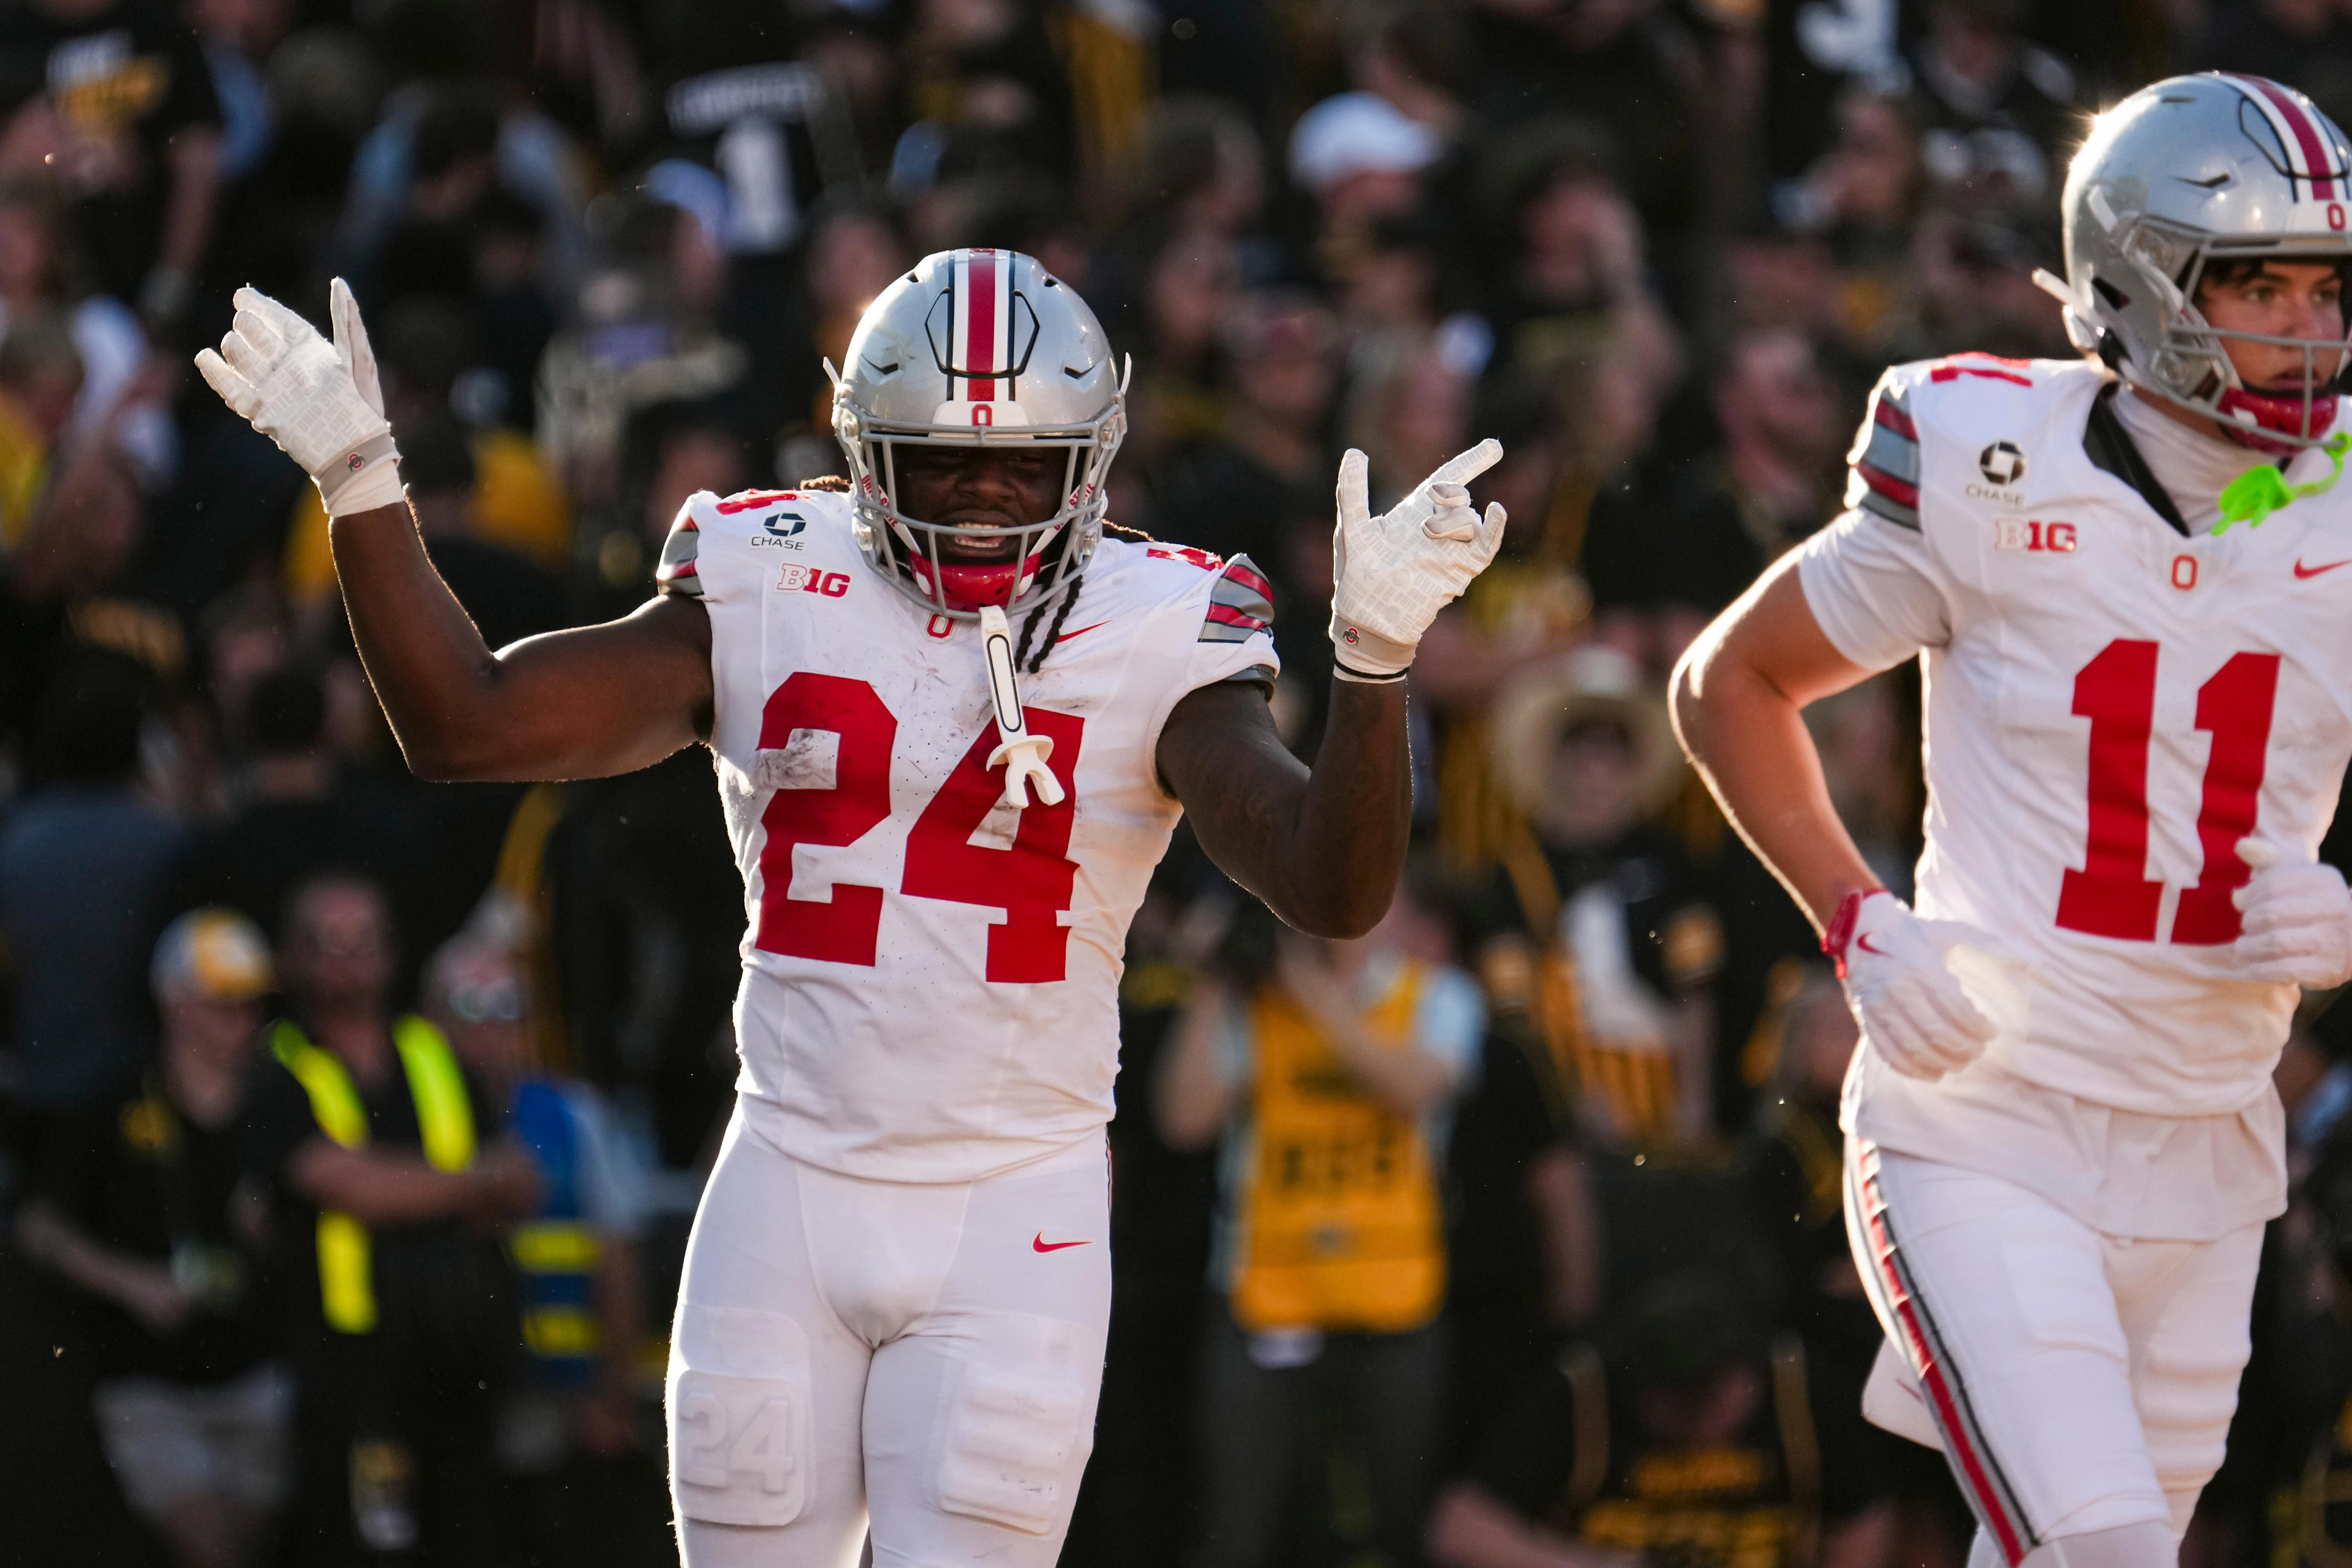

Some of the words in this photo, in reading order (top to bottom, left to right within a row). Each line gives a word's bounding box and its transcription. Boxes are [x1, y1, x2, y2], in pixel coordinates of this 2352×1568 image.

[2327, 202, 2346, 231] O
[972, 403, 993, 427] O
[1965, 483, 2025, 508] CHASE
[751, 536, 806, 551] CHASE
[2171, 554, 2198, 591] O
[2055, 637, 2282, 946] 11
[754, 671, 1085, 984] 24
[679, 1391, 796, 1495] 24
